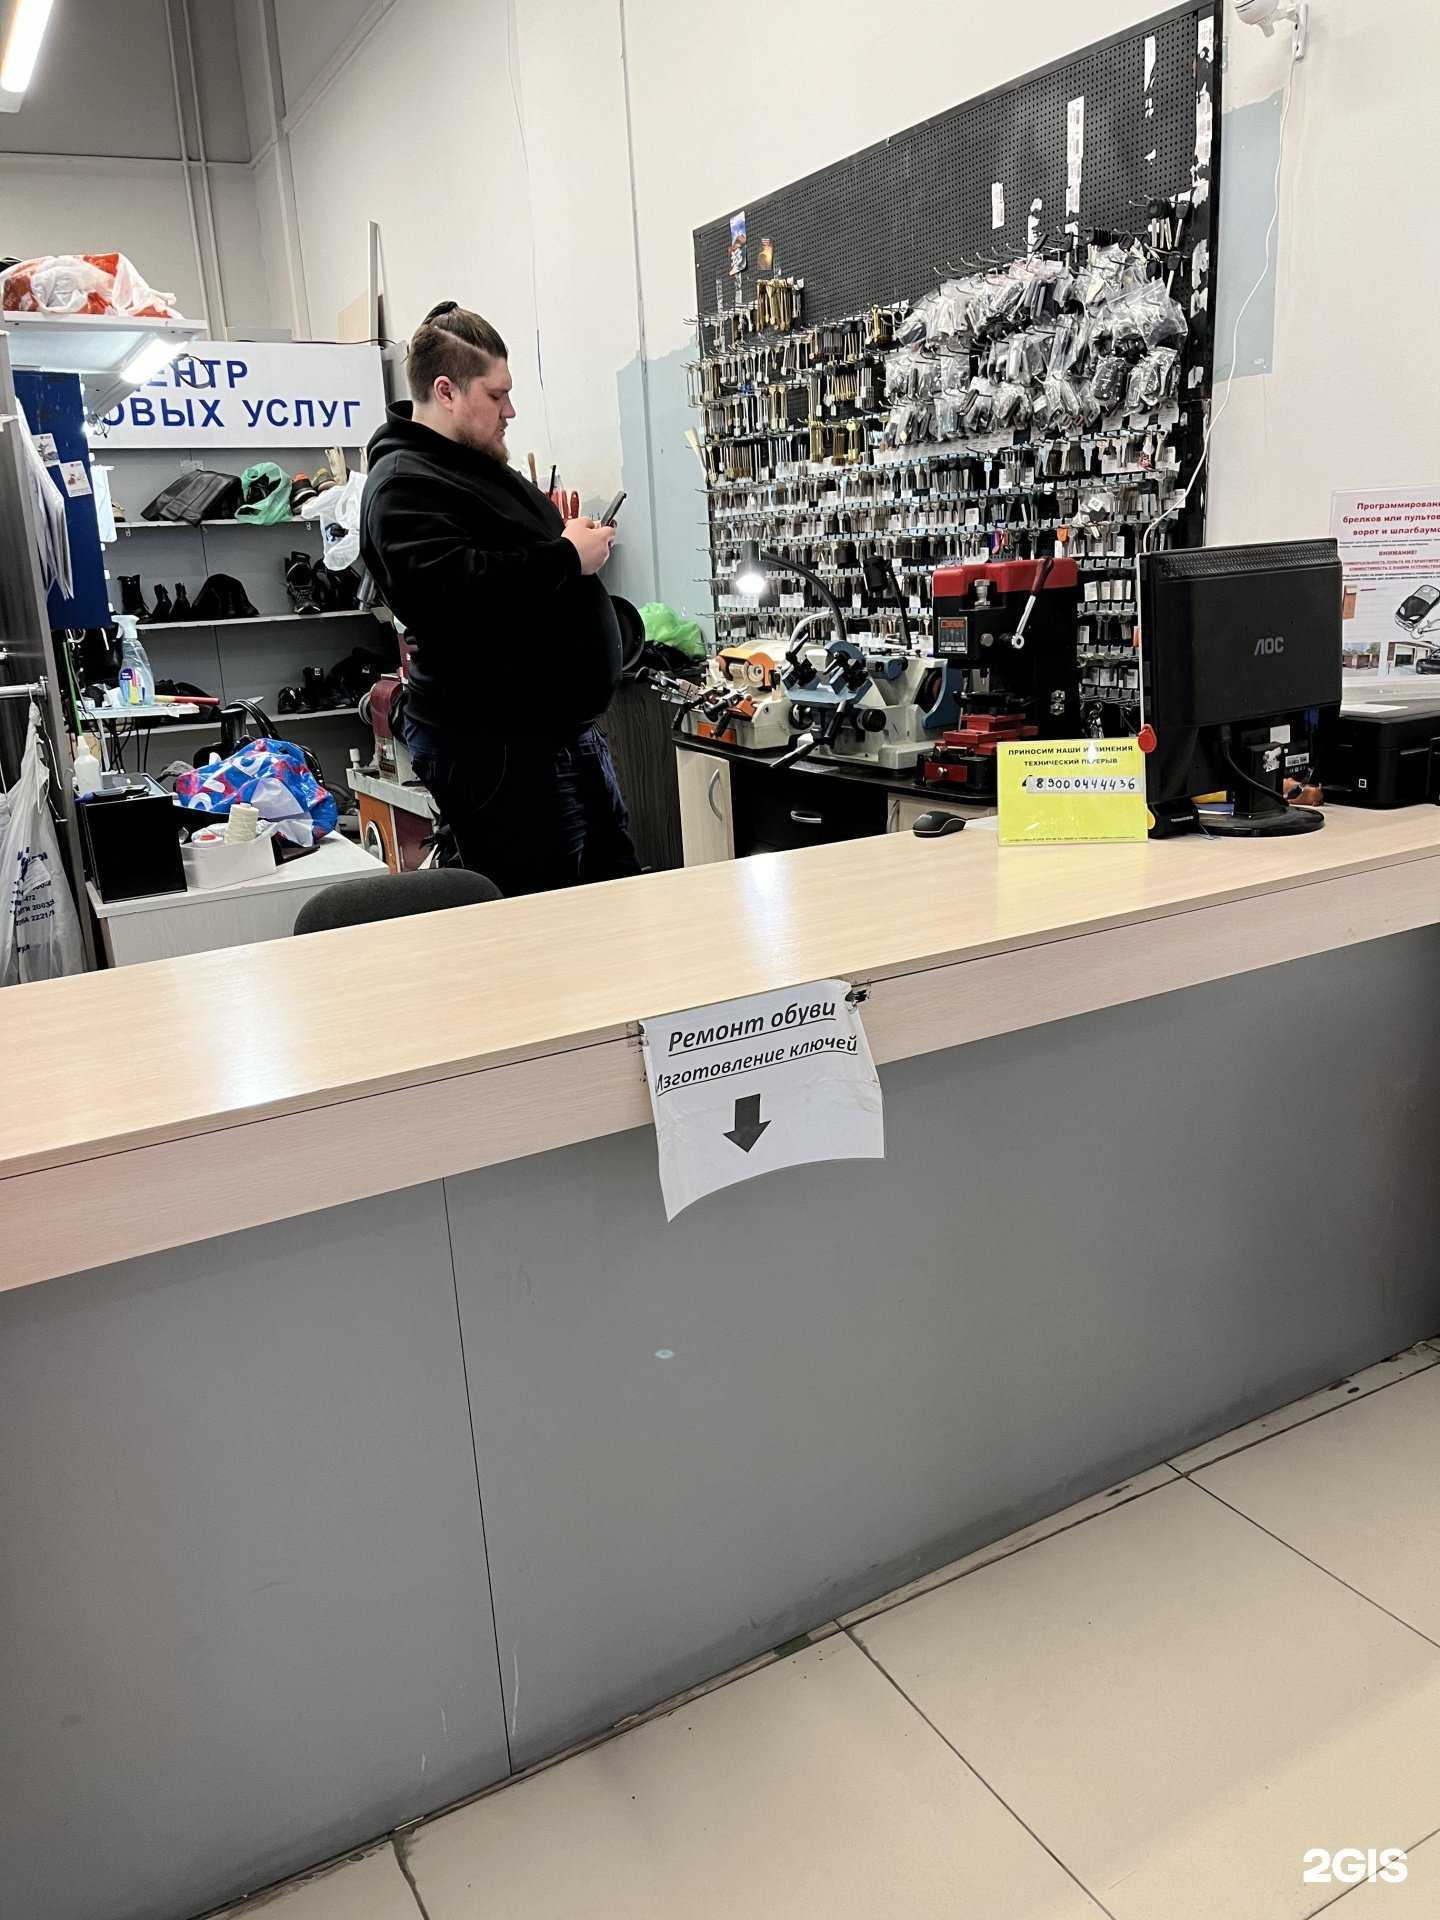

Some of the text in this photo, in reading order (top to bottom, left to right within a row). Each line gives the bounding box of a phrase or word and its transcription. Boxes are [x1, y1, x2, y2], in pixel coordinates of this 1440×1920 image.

[242, 398, 361, 428] УСЛУГ
[1357, 501, 1440, 511] Программирован
[1342, 515, 1381, 524] брелков
[1254, 636, 1285, 656] AOC
[1008, 747, 1054, 756] ПРИНОСИМ
[1024, 758, 1079, 767] ТЕХНИЧЕСКИЙ
[668, 1001, 836, 1052] Ремонт обуви
[789, 1035, 857, 1057] ключей
